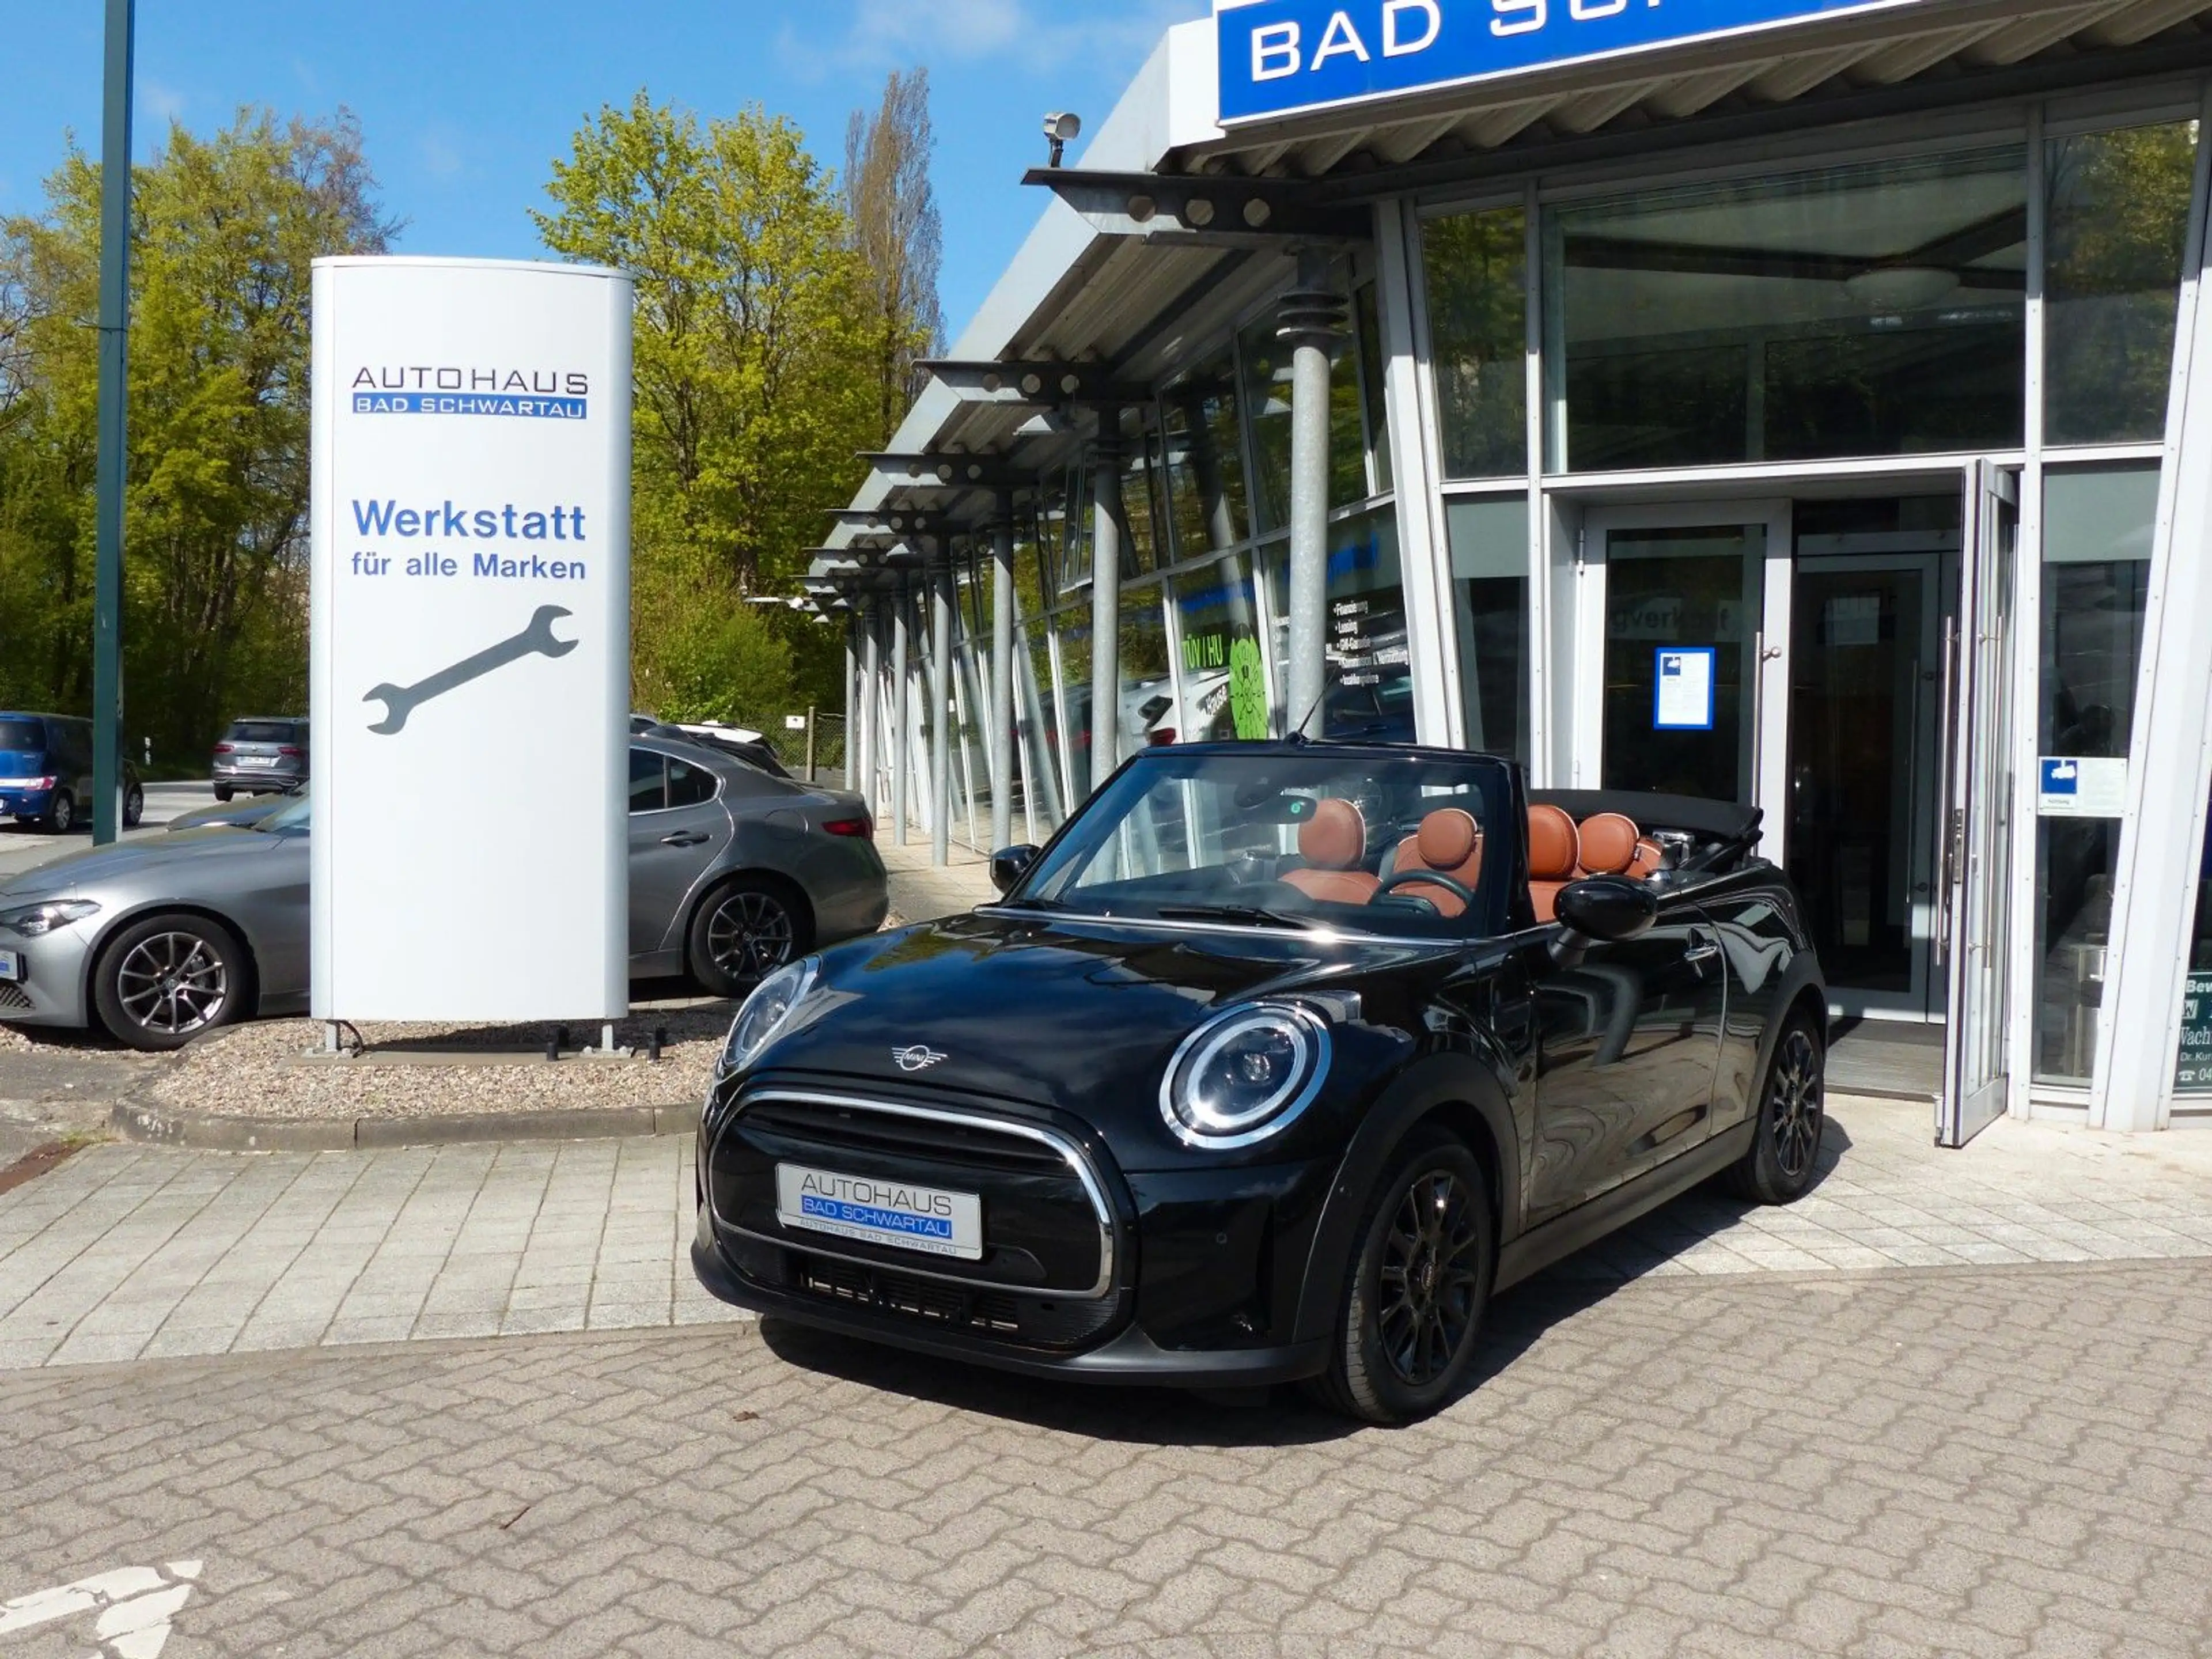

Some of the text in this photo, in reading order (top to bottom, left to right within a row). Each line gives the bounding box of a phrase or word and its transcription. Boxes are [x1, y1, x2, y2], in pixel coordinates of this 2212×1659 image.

[1251, 0, 1441, 82] BAD
[352, 366, 589, 395] AUTOHAUS
[357, 397, 583, 418] BAD SCHWARTAU
[351, 499, 586, 541] Werkstatt
[351, 552, 586, 579] für alle Marken
[801, 1173, 952, 1217] AUTOHAUS
[799, 1218, 957, 1255] AUTOHAUS BAD SCHWARTAU
[803, 1198, 950, 1237] BAD SCHWARTAU
